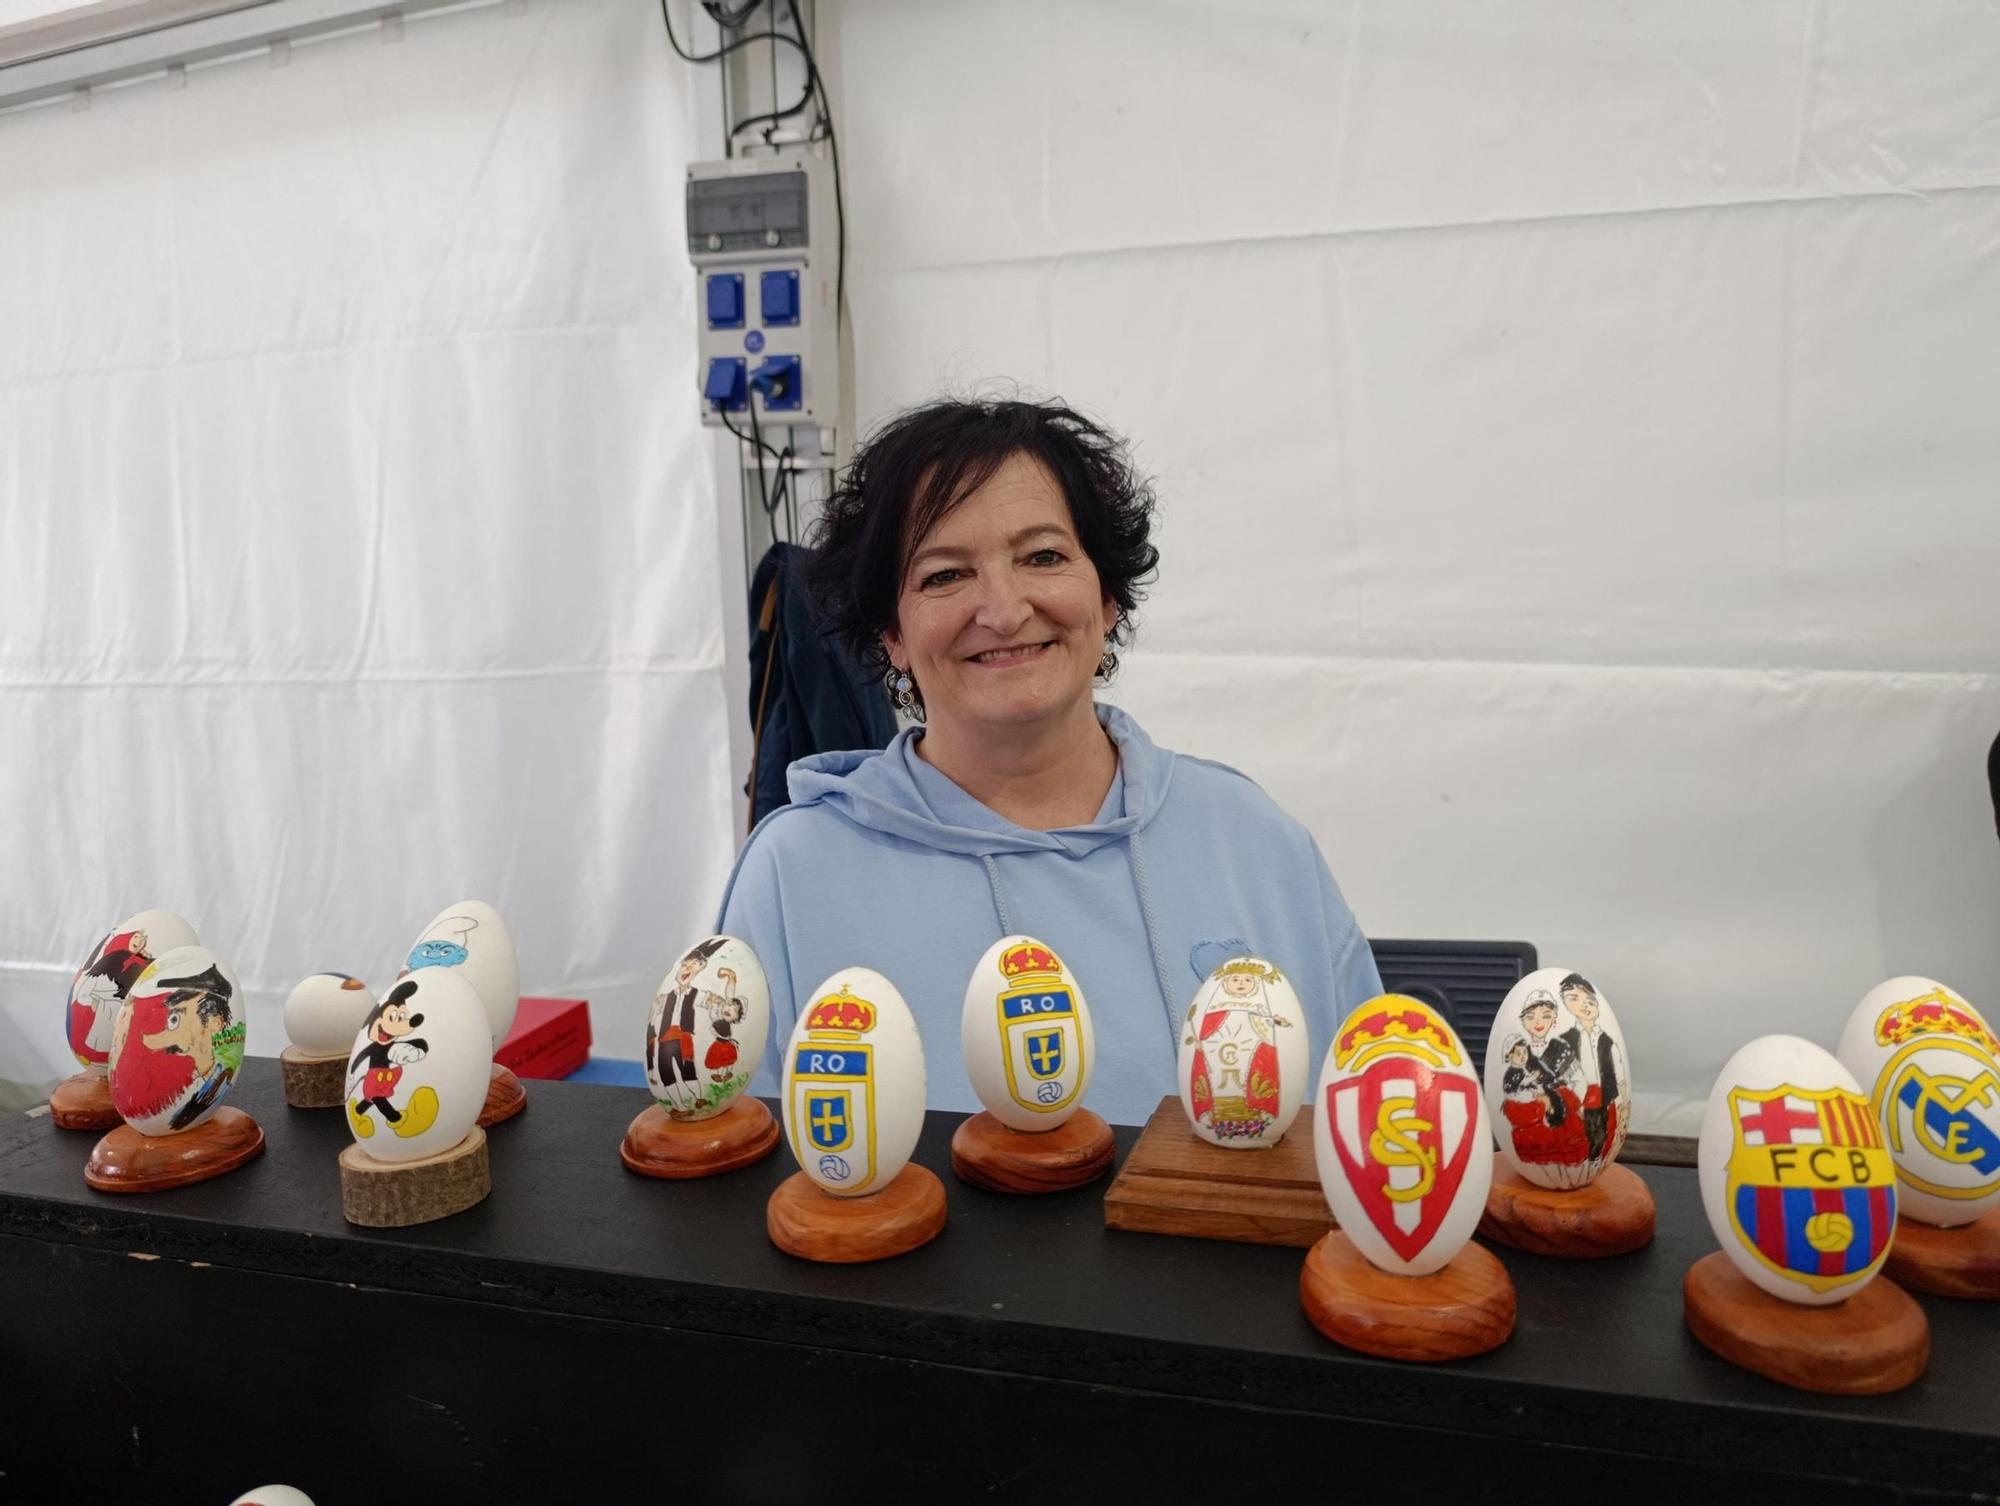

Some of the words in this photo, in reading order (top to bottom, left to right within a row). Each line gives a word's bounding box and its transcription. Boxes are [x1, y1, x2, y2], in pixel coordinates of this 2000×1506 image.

[1020, 996, 1055, 1013] RO
[809, 1054, 846, 1073] RO
[1769, 1148, 1871, 1184] FCB
